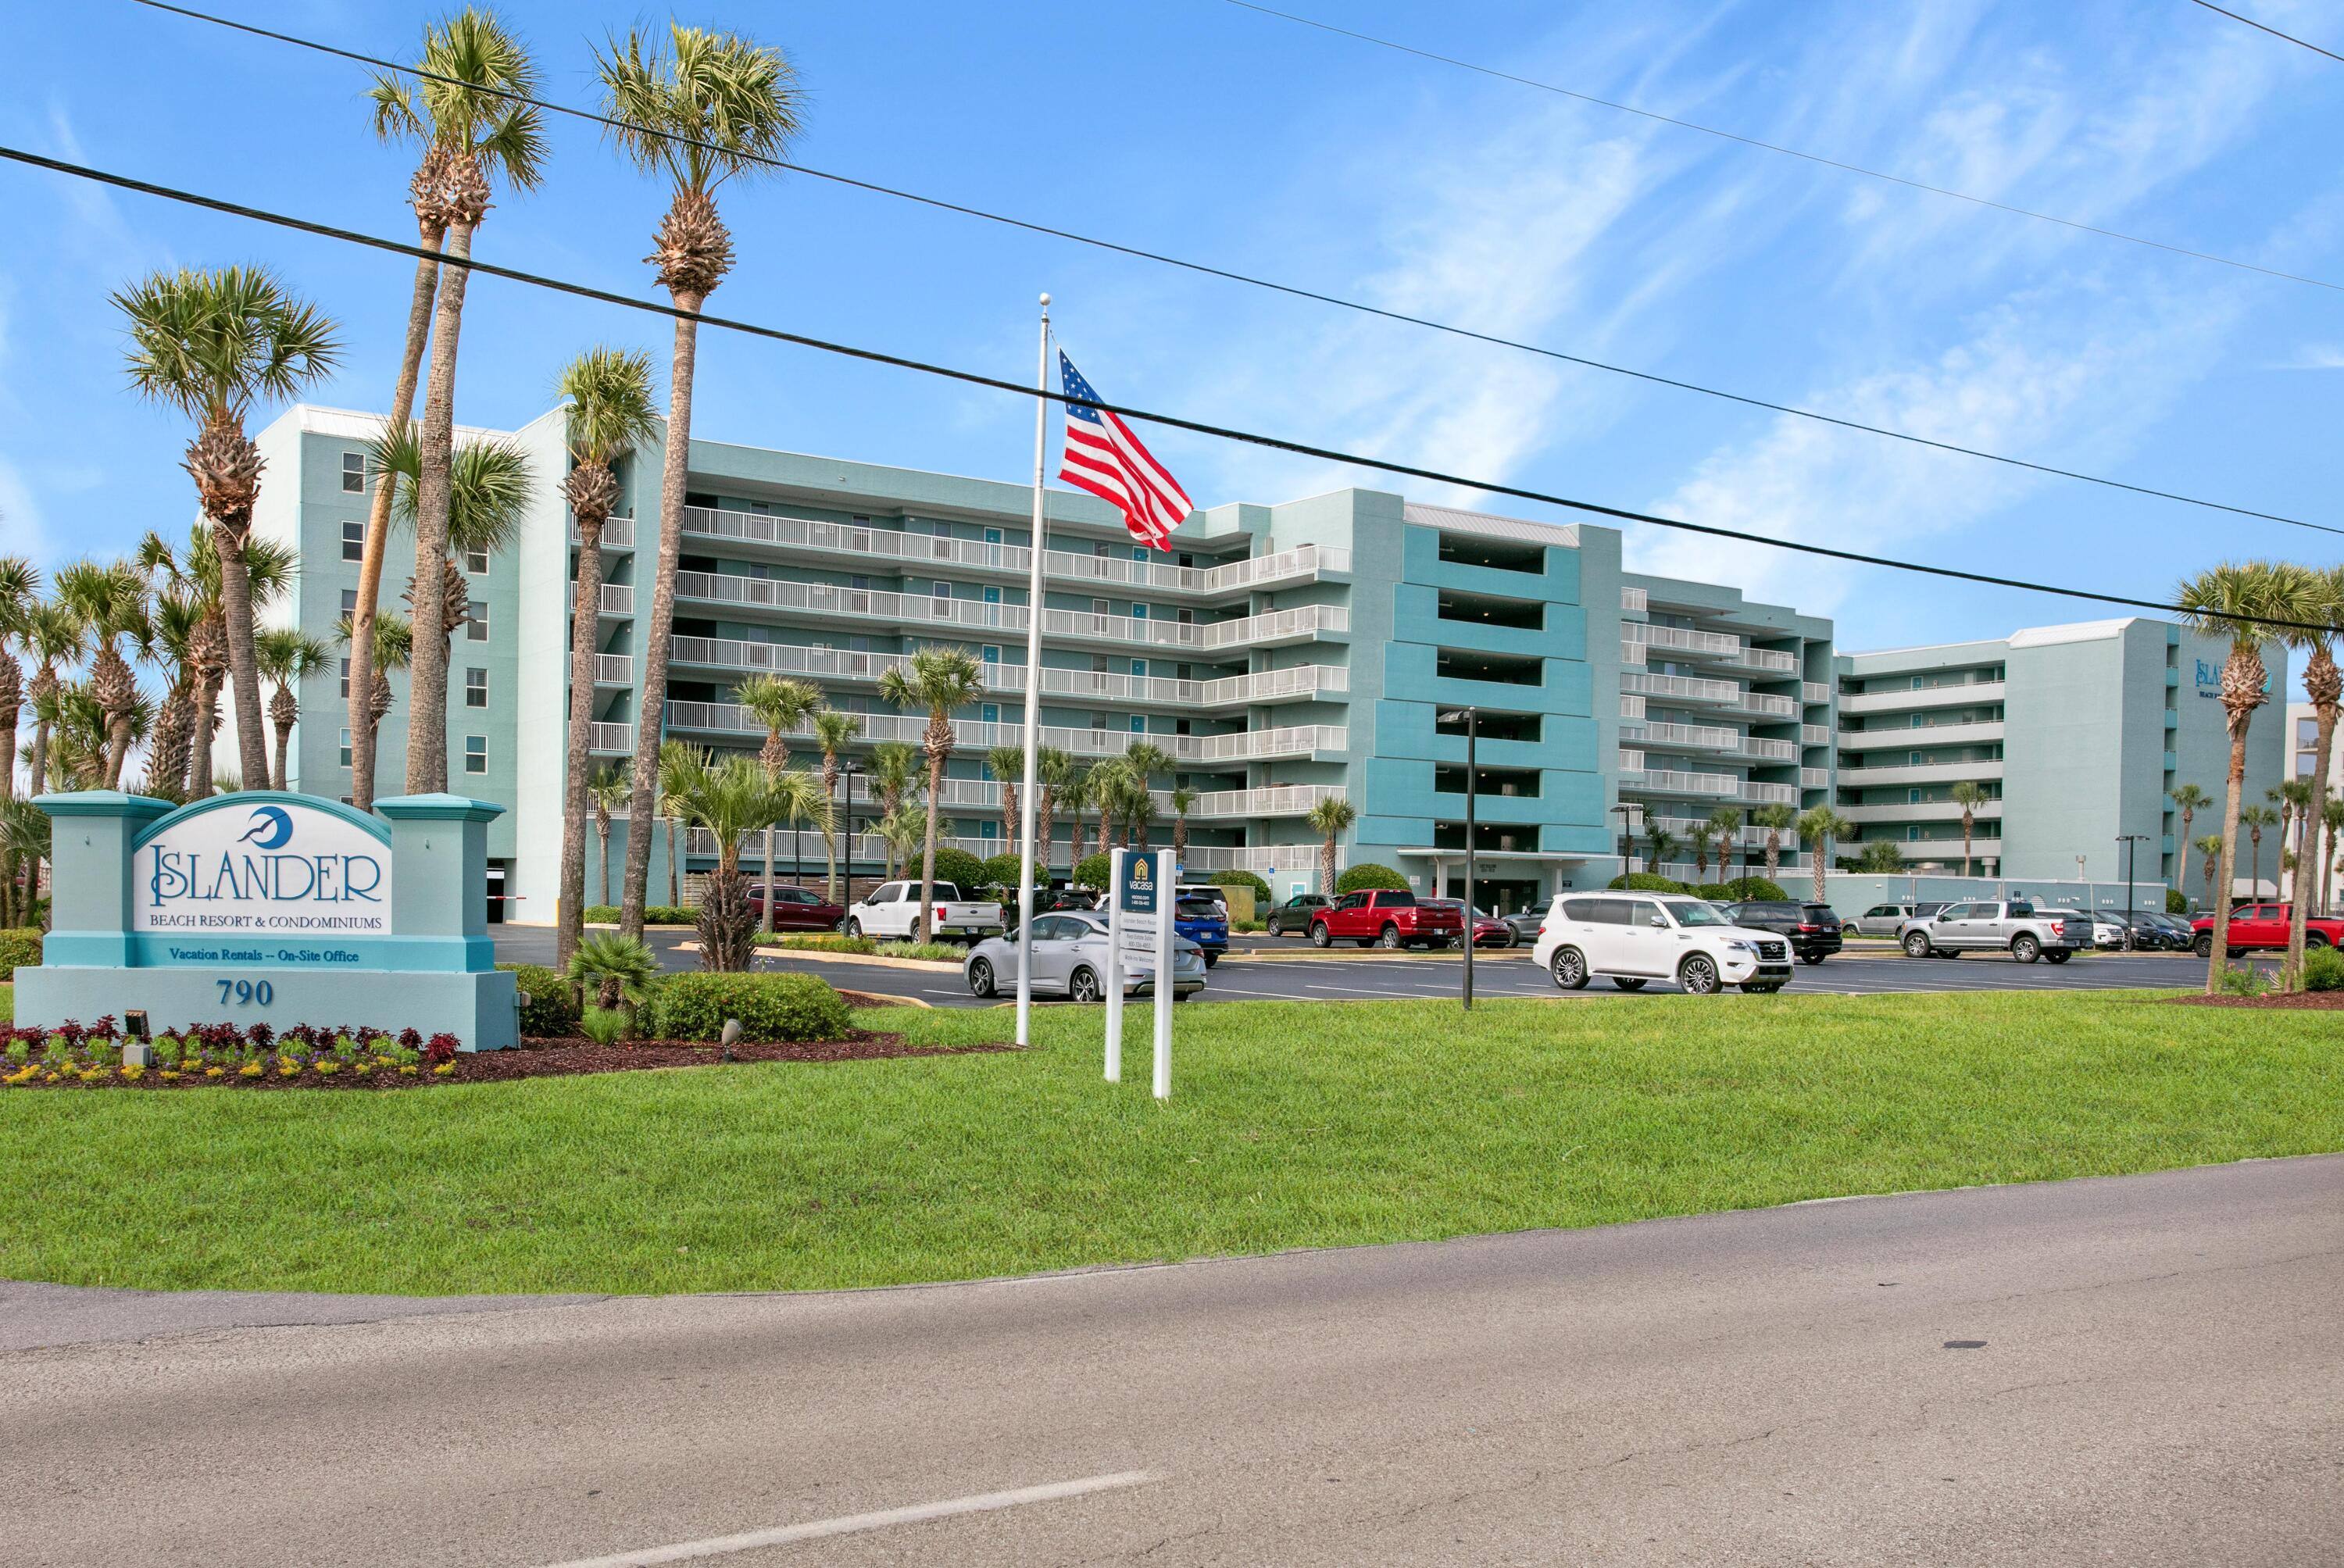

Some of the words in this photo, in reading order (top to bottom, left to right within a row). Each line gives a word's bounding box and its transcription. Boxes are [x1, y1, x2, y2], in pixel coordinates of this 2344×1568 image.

[149, 845, 382, 907] ISLANDER
[1129, 880, 1153, 891] vacasa
[149, 914, 195, 927] BEACH
[200, 915, 252, 927] RESORT
[255, 916, 266, 927] &
[269, 916, 382, 929] CONDOMINIUMS
[170, 948, 219, 960] Vacation
[221, 948, 263, 961] Rentals
[277, 949, 320, 962] On-Site
[323, 950, 359, 962] Office
[216, 979, 273, 1005] 790
